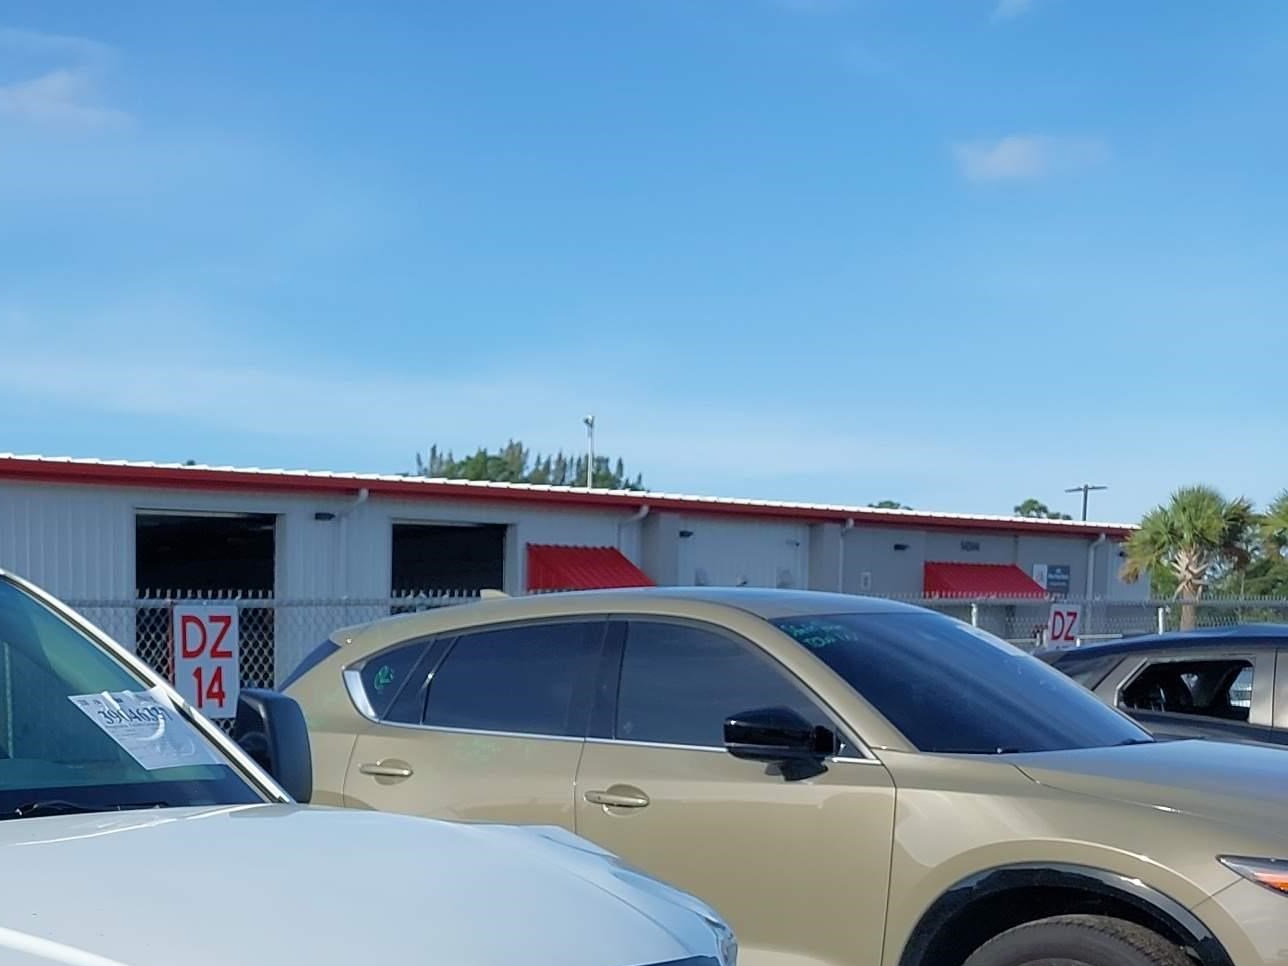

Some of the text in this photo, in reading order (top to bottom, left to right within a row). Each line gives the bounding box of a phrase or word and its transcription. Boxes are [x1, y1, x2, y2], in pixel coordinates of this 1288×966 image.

[180, 614, 234, 660] DZ
[1050, 611, 1078, 642] DZ
[192, 666, 226, 709] 14
